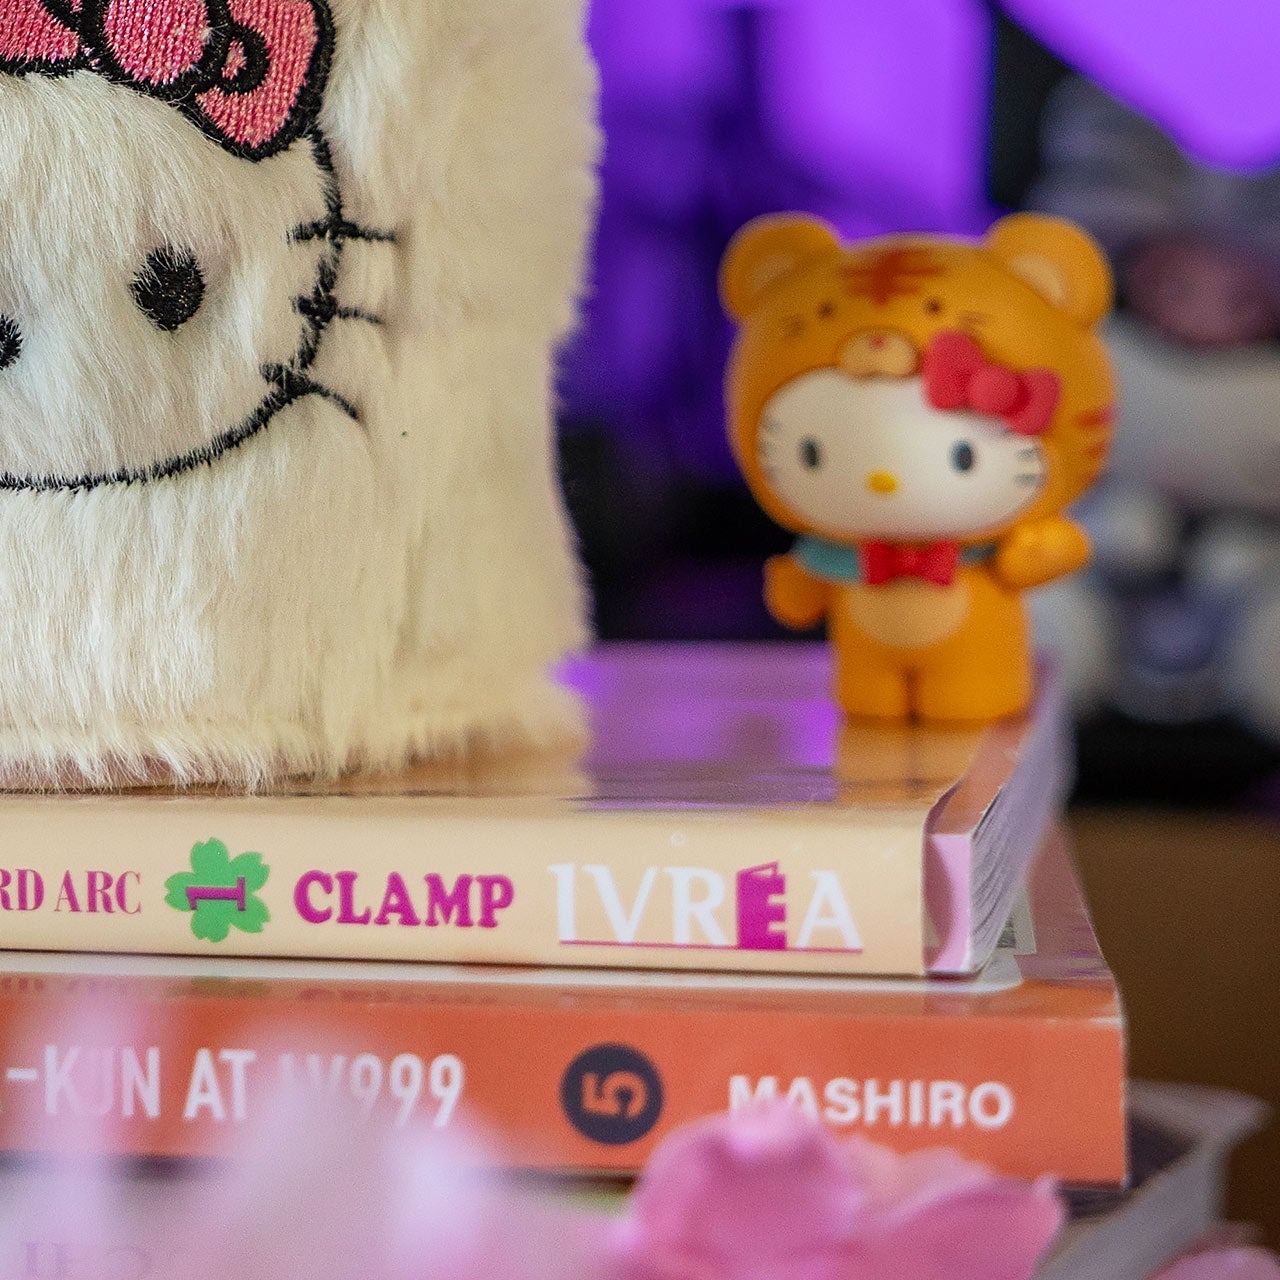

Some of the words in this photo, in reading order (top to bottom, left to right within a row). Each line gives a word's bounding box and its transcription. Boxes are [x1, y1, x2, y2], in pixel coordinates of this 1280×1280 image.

[54, 869, 143, 914] ARC
[186, 876, 246, 912] 1
[293, 869, 515, 928] CLAMP
[547, 861, 864, 950] IVREA
[184, 1047, 257, 1120] AT
[581, 1070, 649, 1120] 5
[728, 1074, 1015, 1129] MASHIRO
